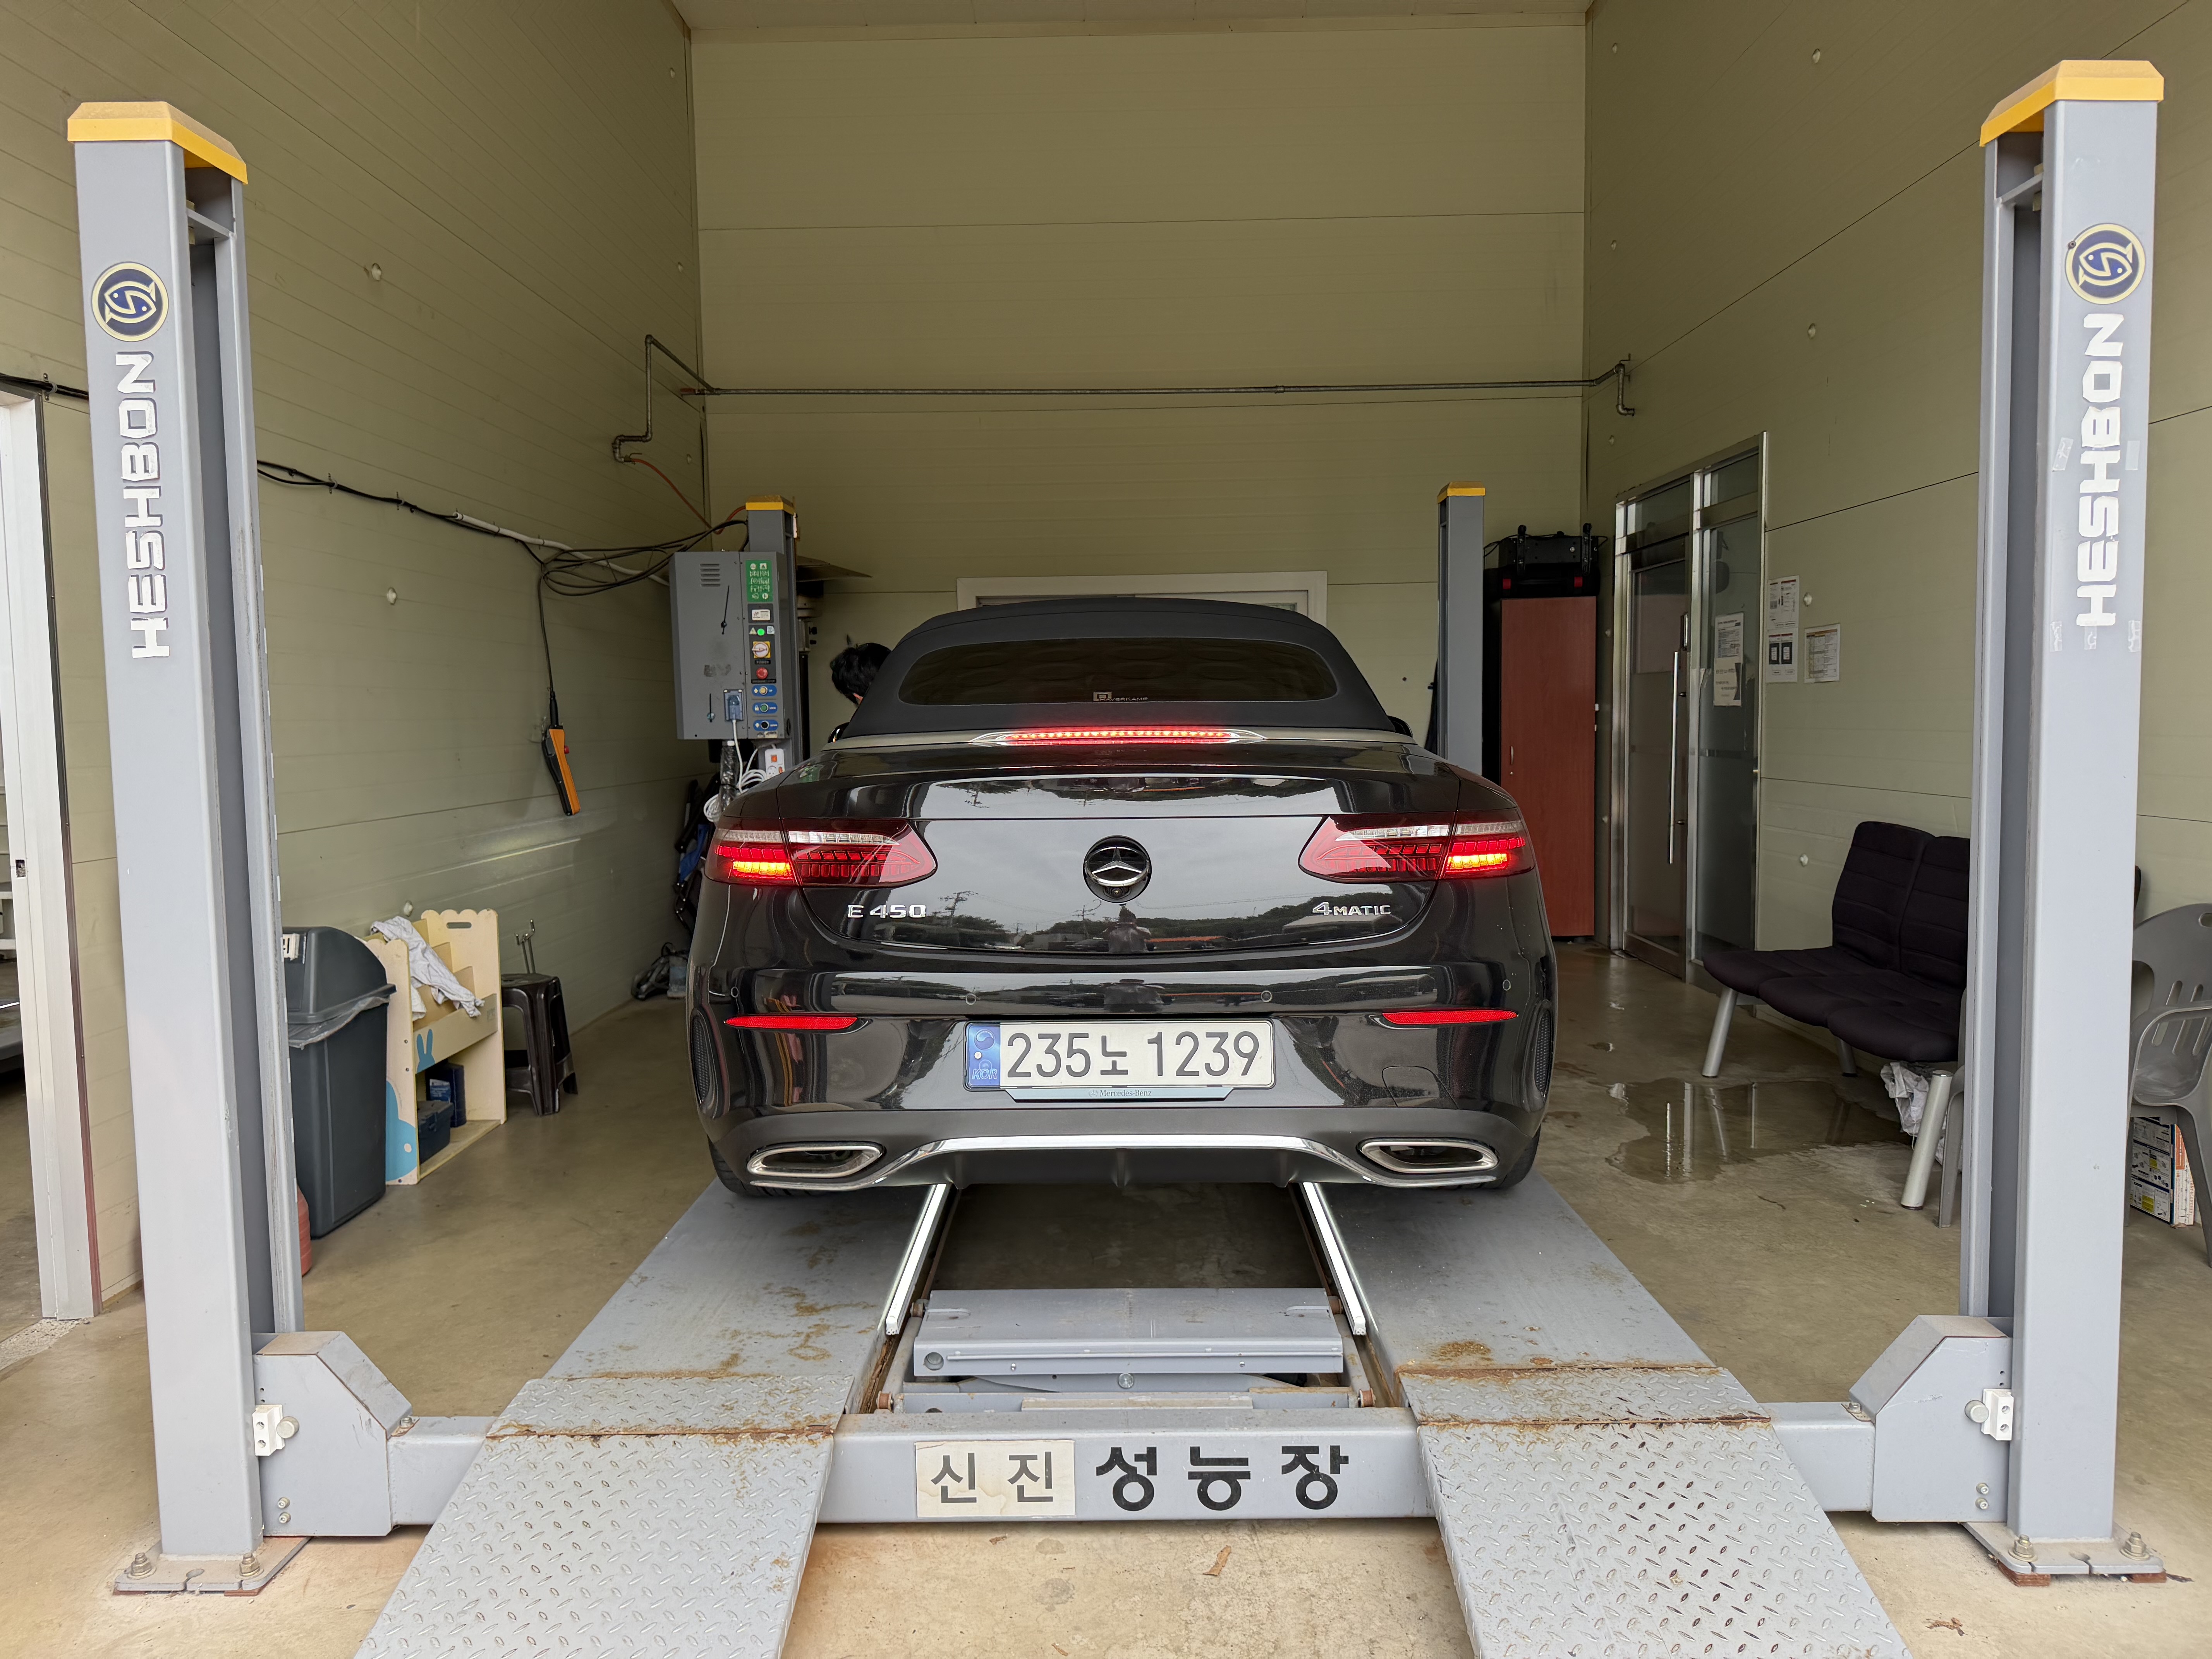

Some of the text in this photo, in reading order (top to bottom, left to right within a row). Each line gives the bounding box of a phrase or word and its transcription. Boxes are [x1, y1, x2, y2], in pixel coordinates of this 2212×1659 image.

[2076, 313, 2124, 627] HESHBON
[116, 351, 170, 659] HESHBON
[847, 905, 926, 918] E 450
[1312, 902, 1391, 915] 4MATIC
[1007, 1031, 1260, 1078] 235노 1239
[972, 1068, 998, 1080] KOR
